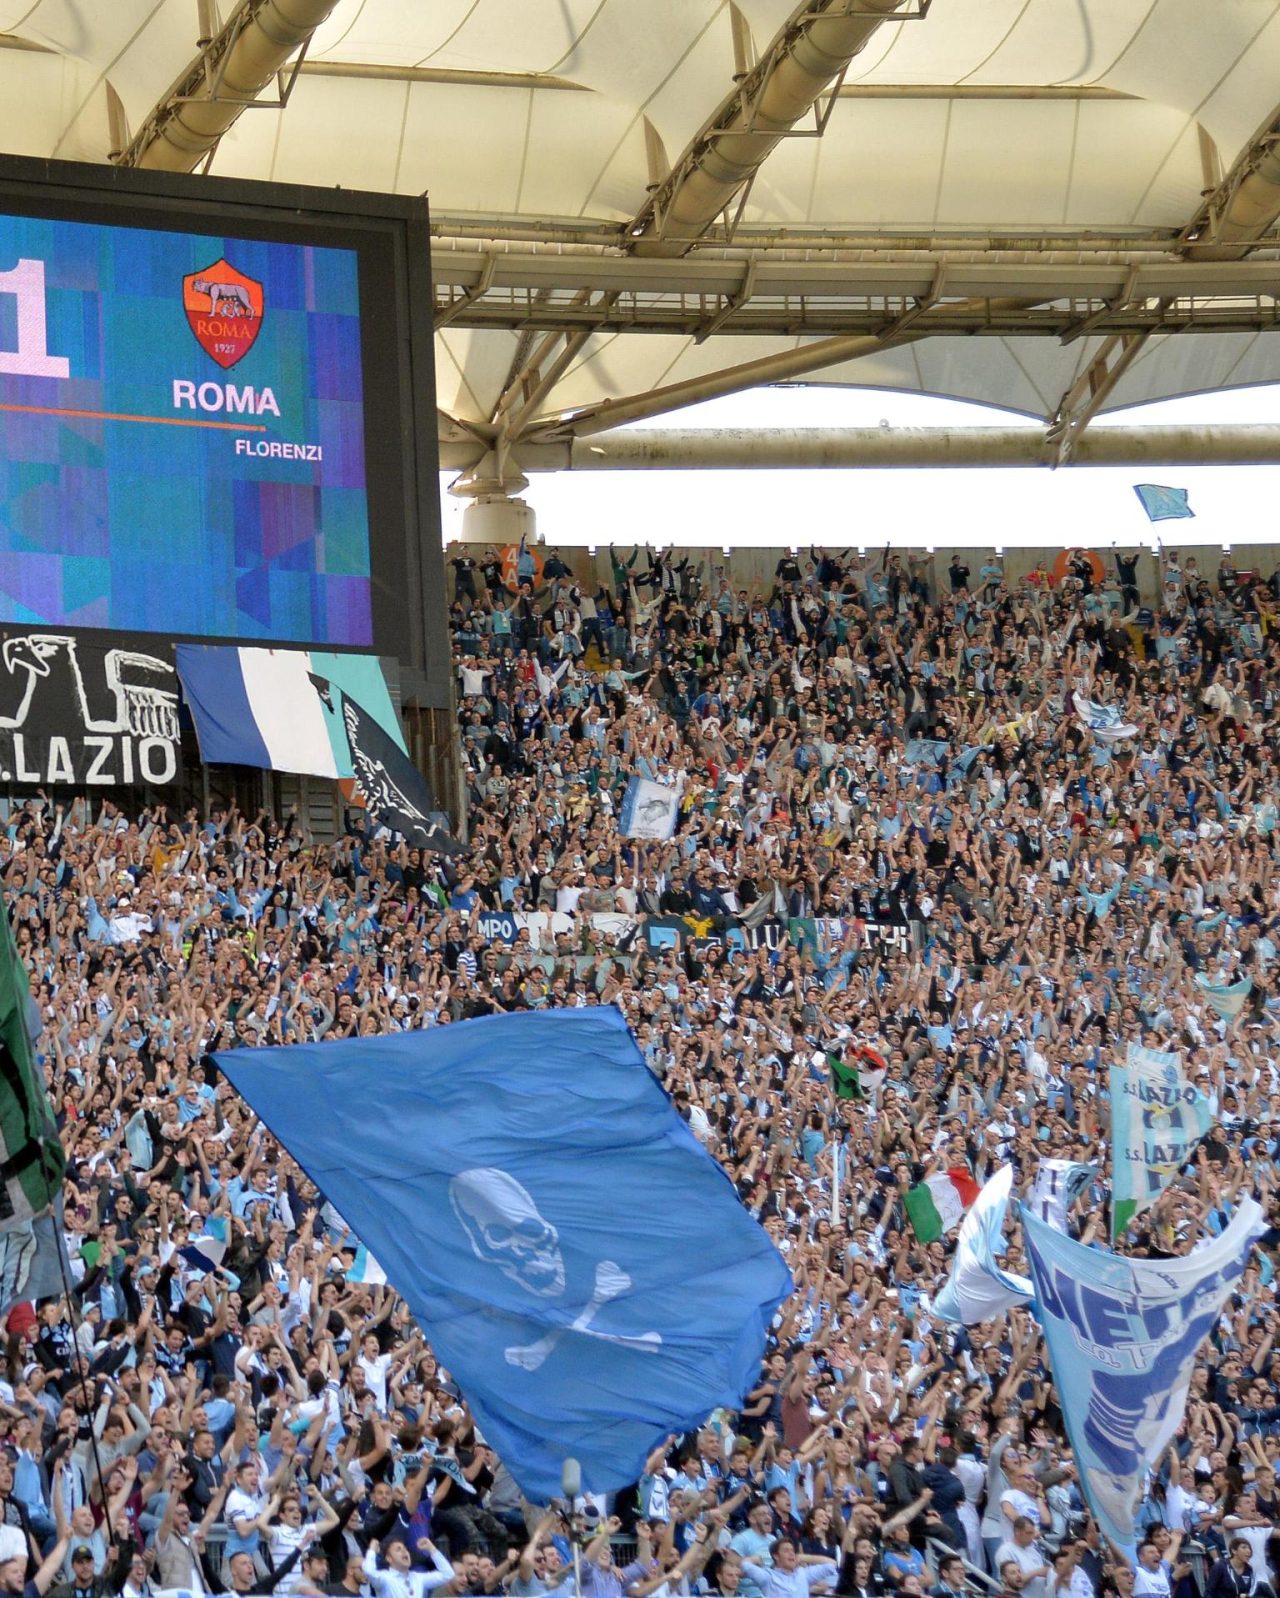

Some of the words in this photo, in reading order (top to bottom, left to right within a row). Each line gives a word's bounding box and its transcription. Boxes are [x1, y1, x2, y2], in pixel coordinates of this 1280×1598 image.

[196, 320, 252, 340] ROMA
[214, 343, 236, 355] 1927
[173, 379, 281, 417] ROMA
[235, 439, 323, 461] FLORENZI
